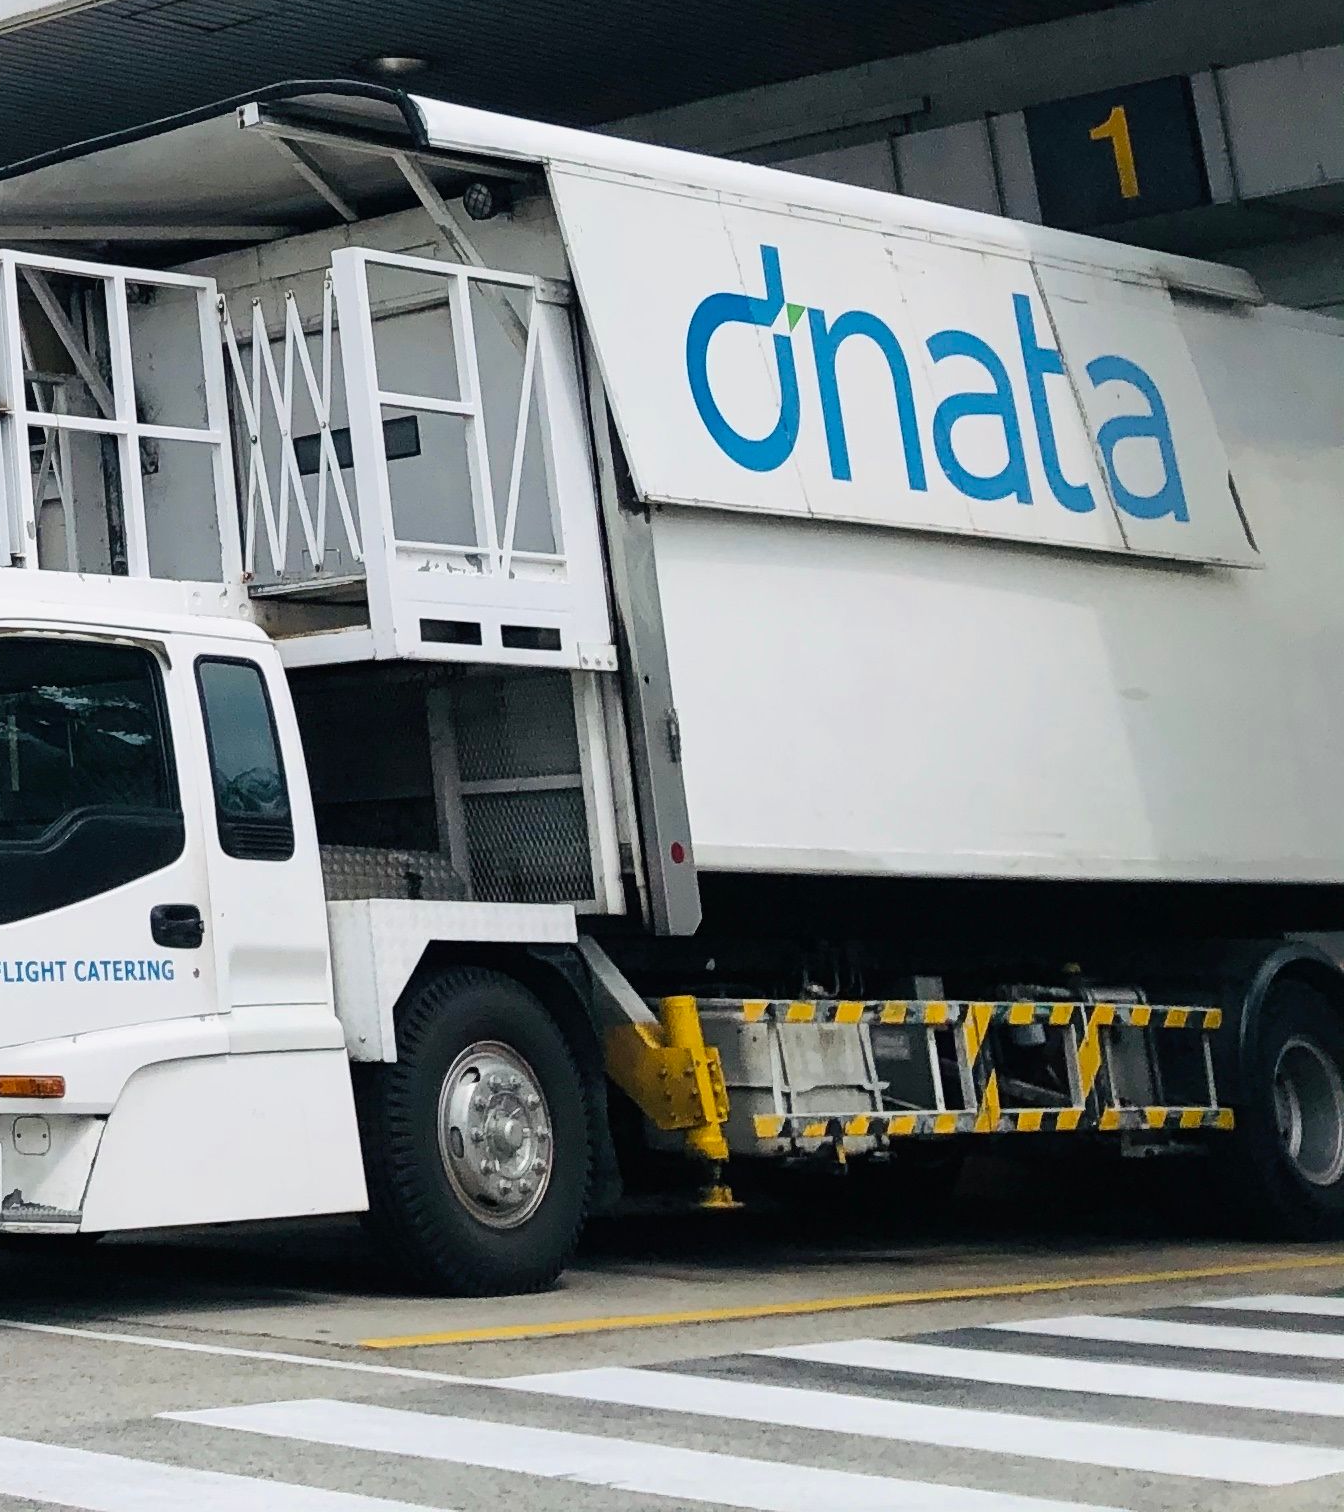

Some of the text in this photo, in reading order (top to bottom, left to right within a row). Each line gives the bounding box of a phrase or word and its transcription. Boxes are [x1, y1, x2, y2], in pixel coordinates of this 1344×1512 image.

[1089, 104, 1141, 200] 1
[686, 244, 1190, 523] dnata
[73, 959, 175, 982] CATERING
